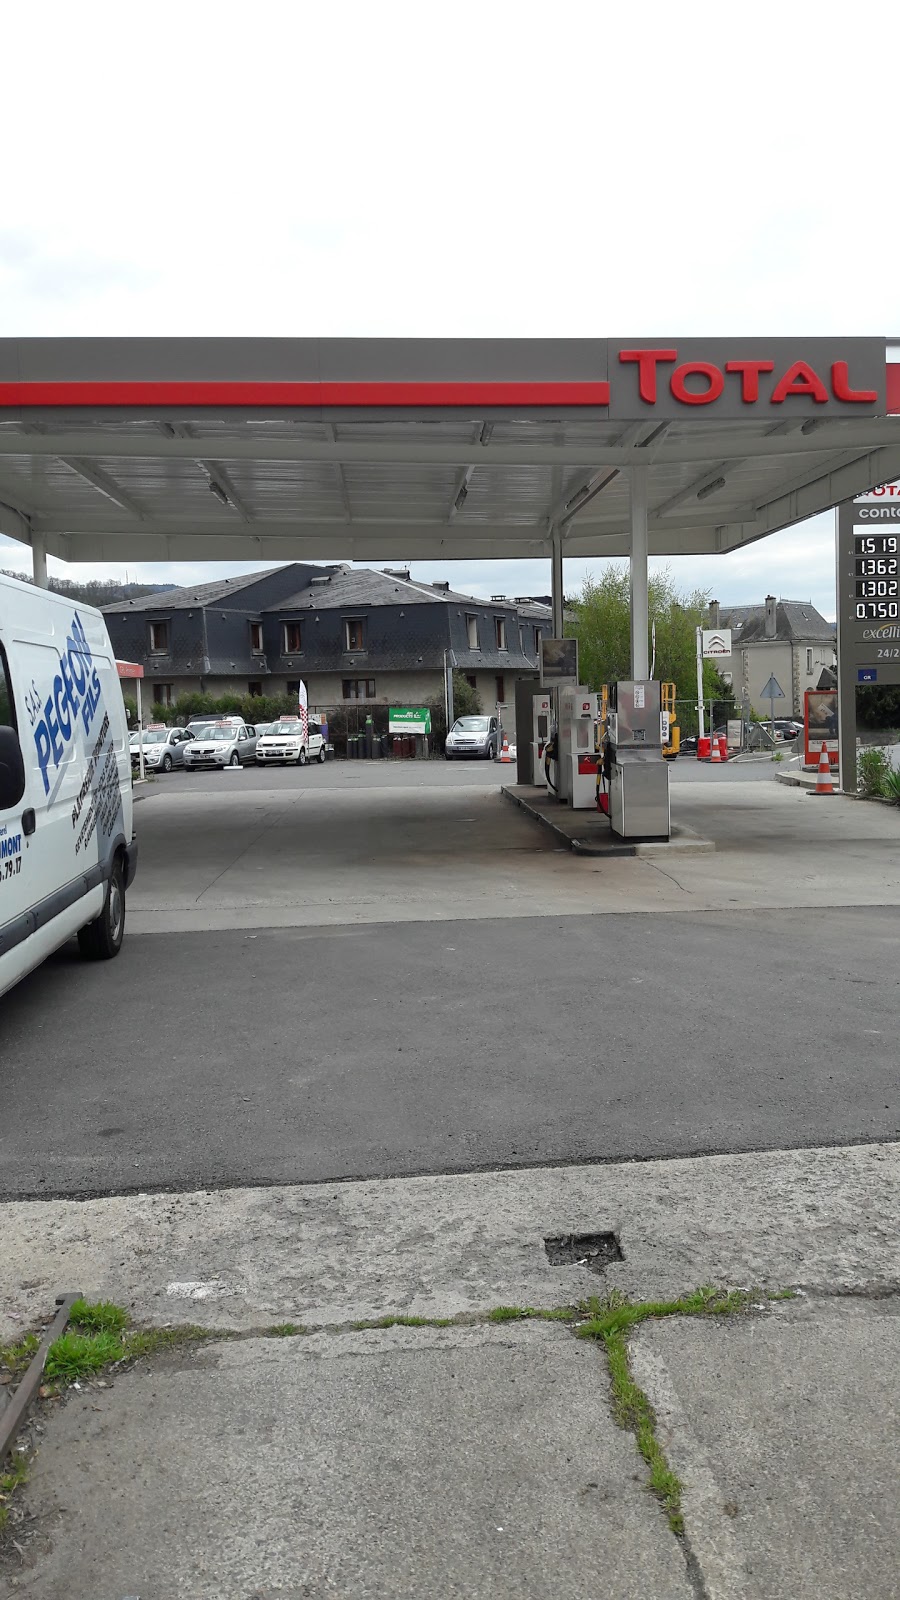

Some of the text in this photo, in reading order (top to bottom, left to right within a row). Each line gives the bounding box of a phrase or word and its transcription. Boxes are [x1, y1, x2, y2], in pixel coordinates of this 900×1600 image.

[618, 349, 878, 406] TOTAL
[861, 559, 897, 575] 1.362
[862, 581, 898, 597] 1.302
[856, 602, 898, 619] 0.750
[81, 665, 101, 737] FILS
